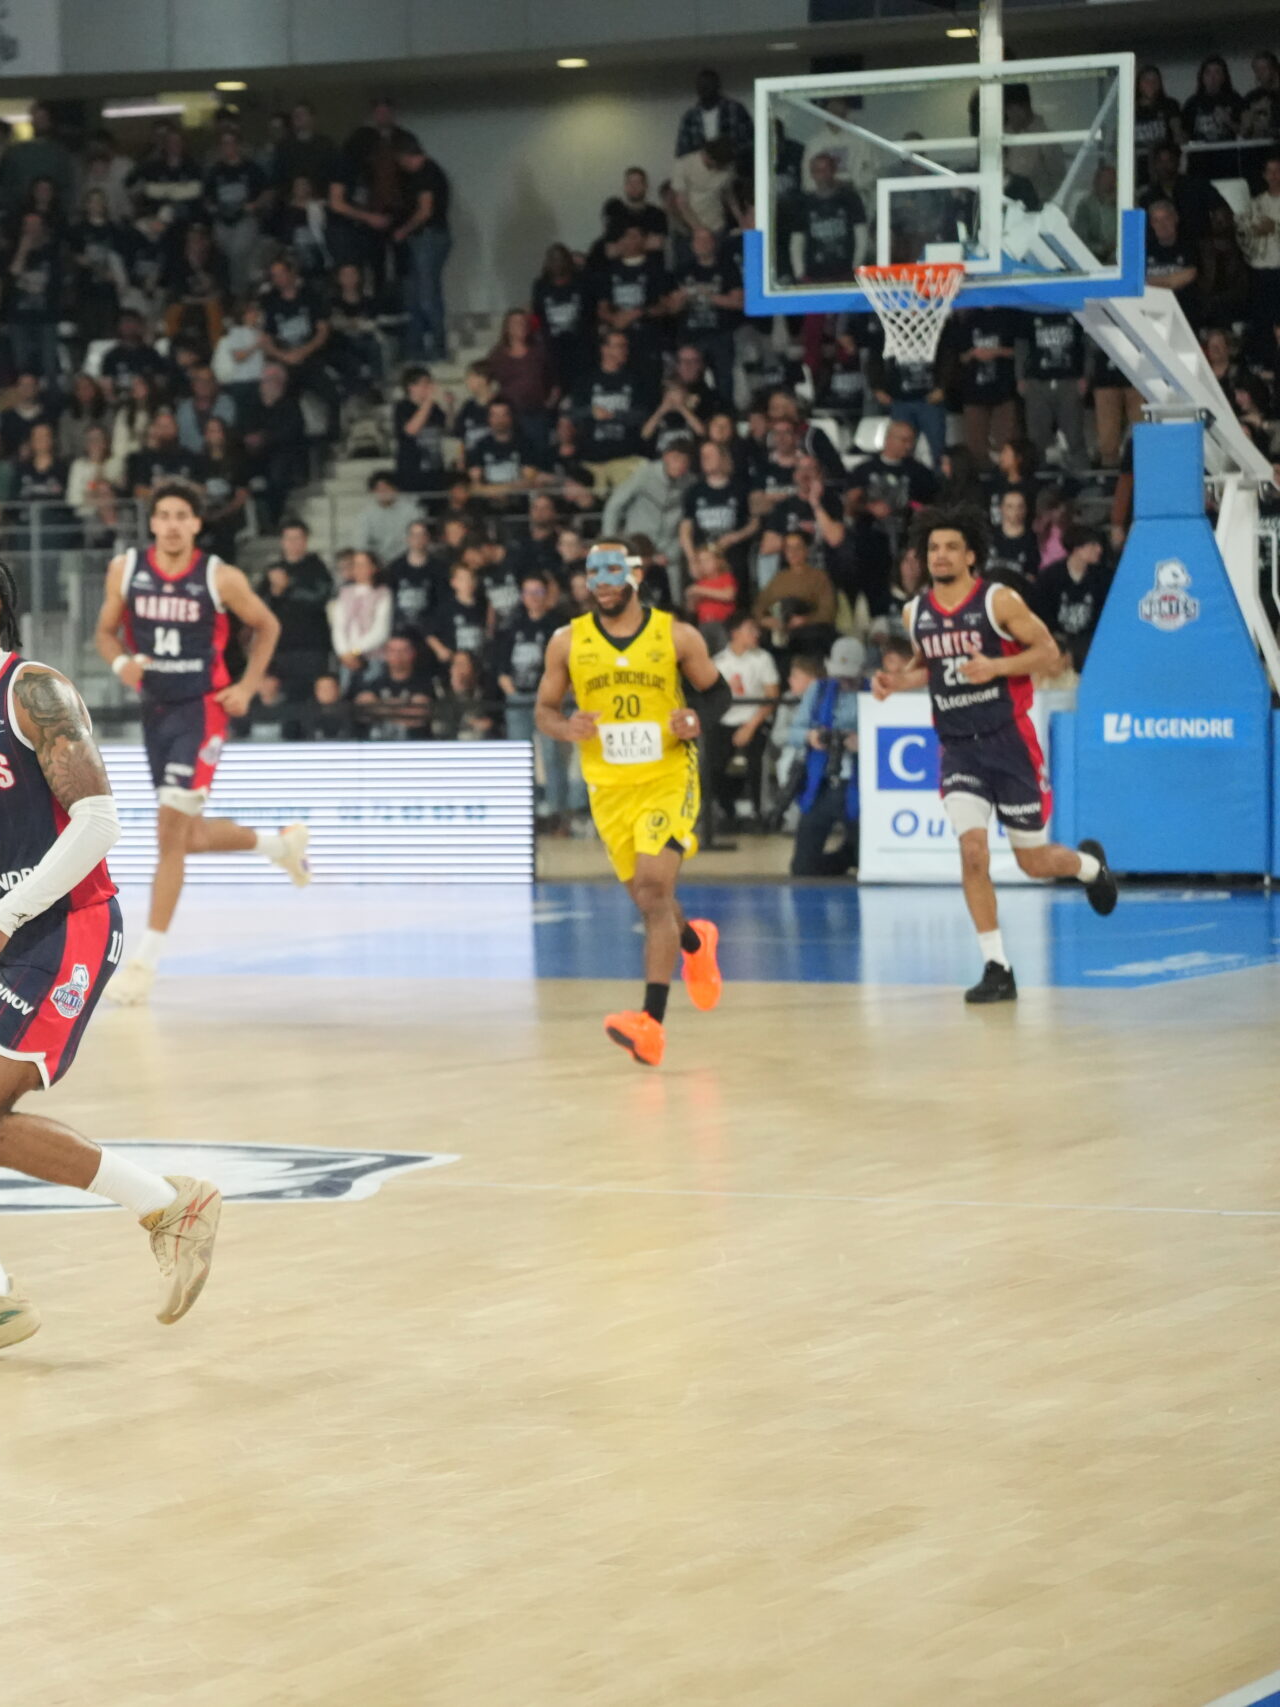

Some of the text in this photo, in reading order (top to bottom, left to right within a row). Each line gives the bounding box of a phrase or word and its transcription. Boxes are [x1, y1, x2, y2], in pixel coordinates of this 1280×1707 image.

[154, 626, 180, 657] 14
[613, 694, 641, 719] 20
[1133, 717, 1235, 739] LEGENDRE
